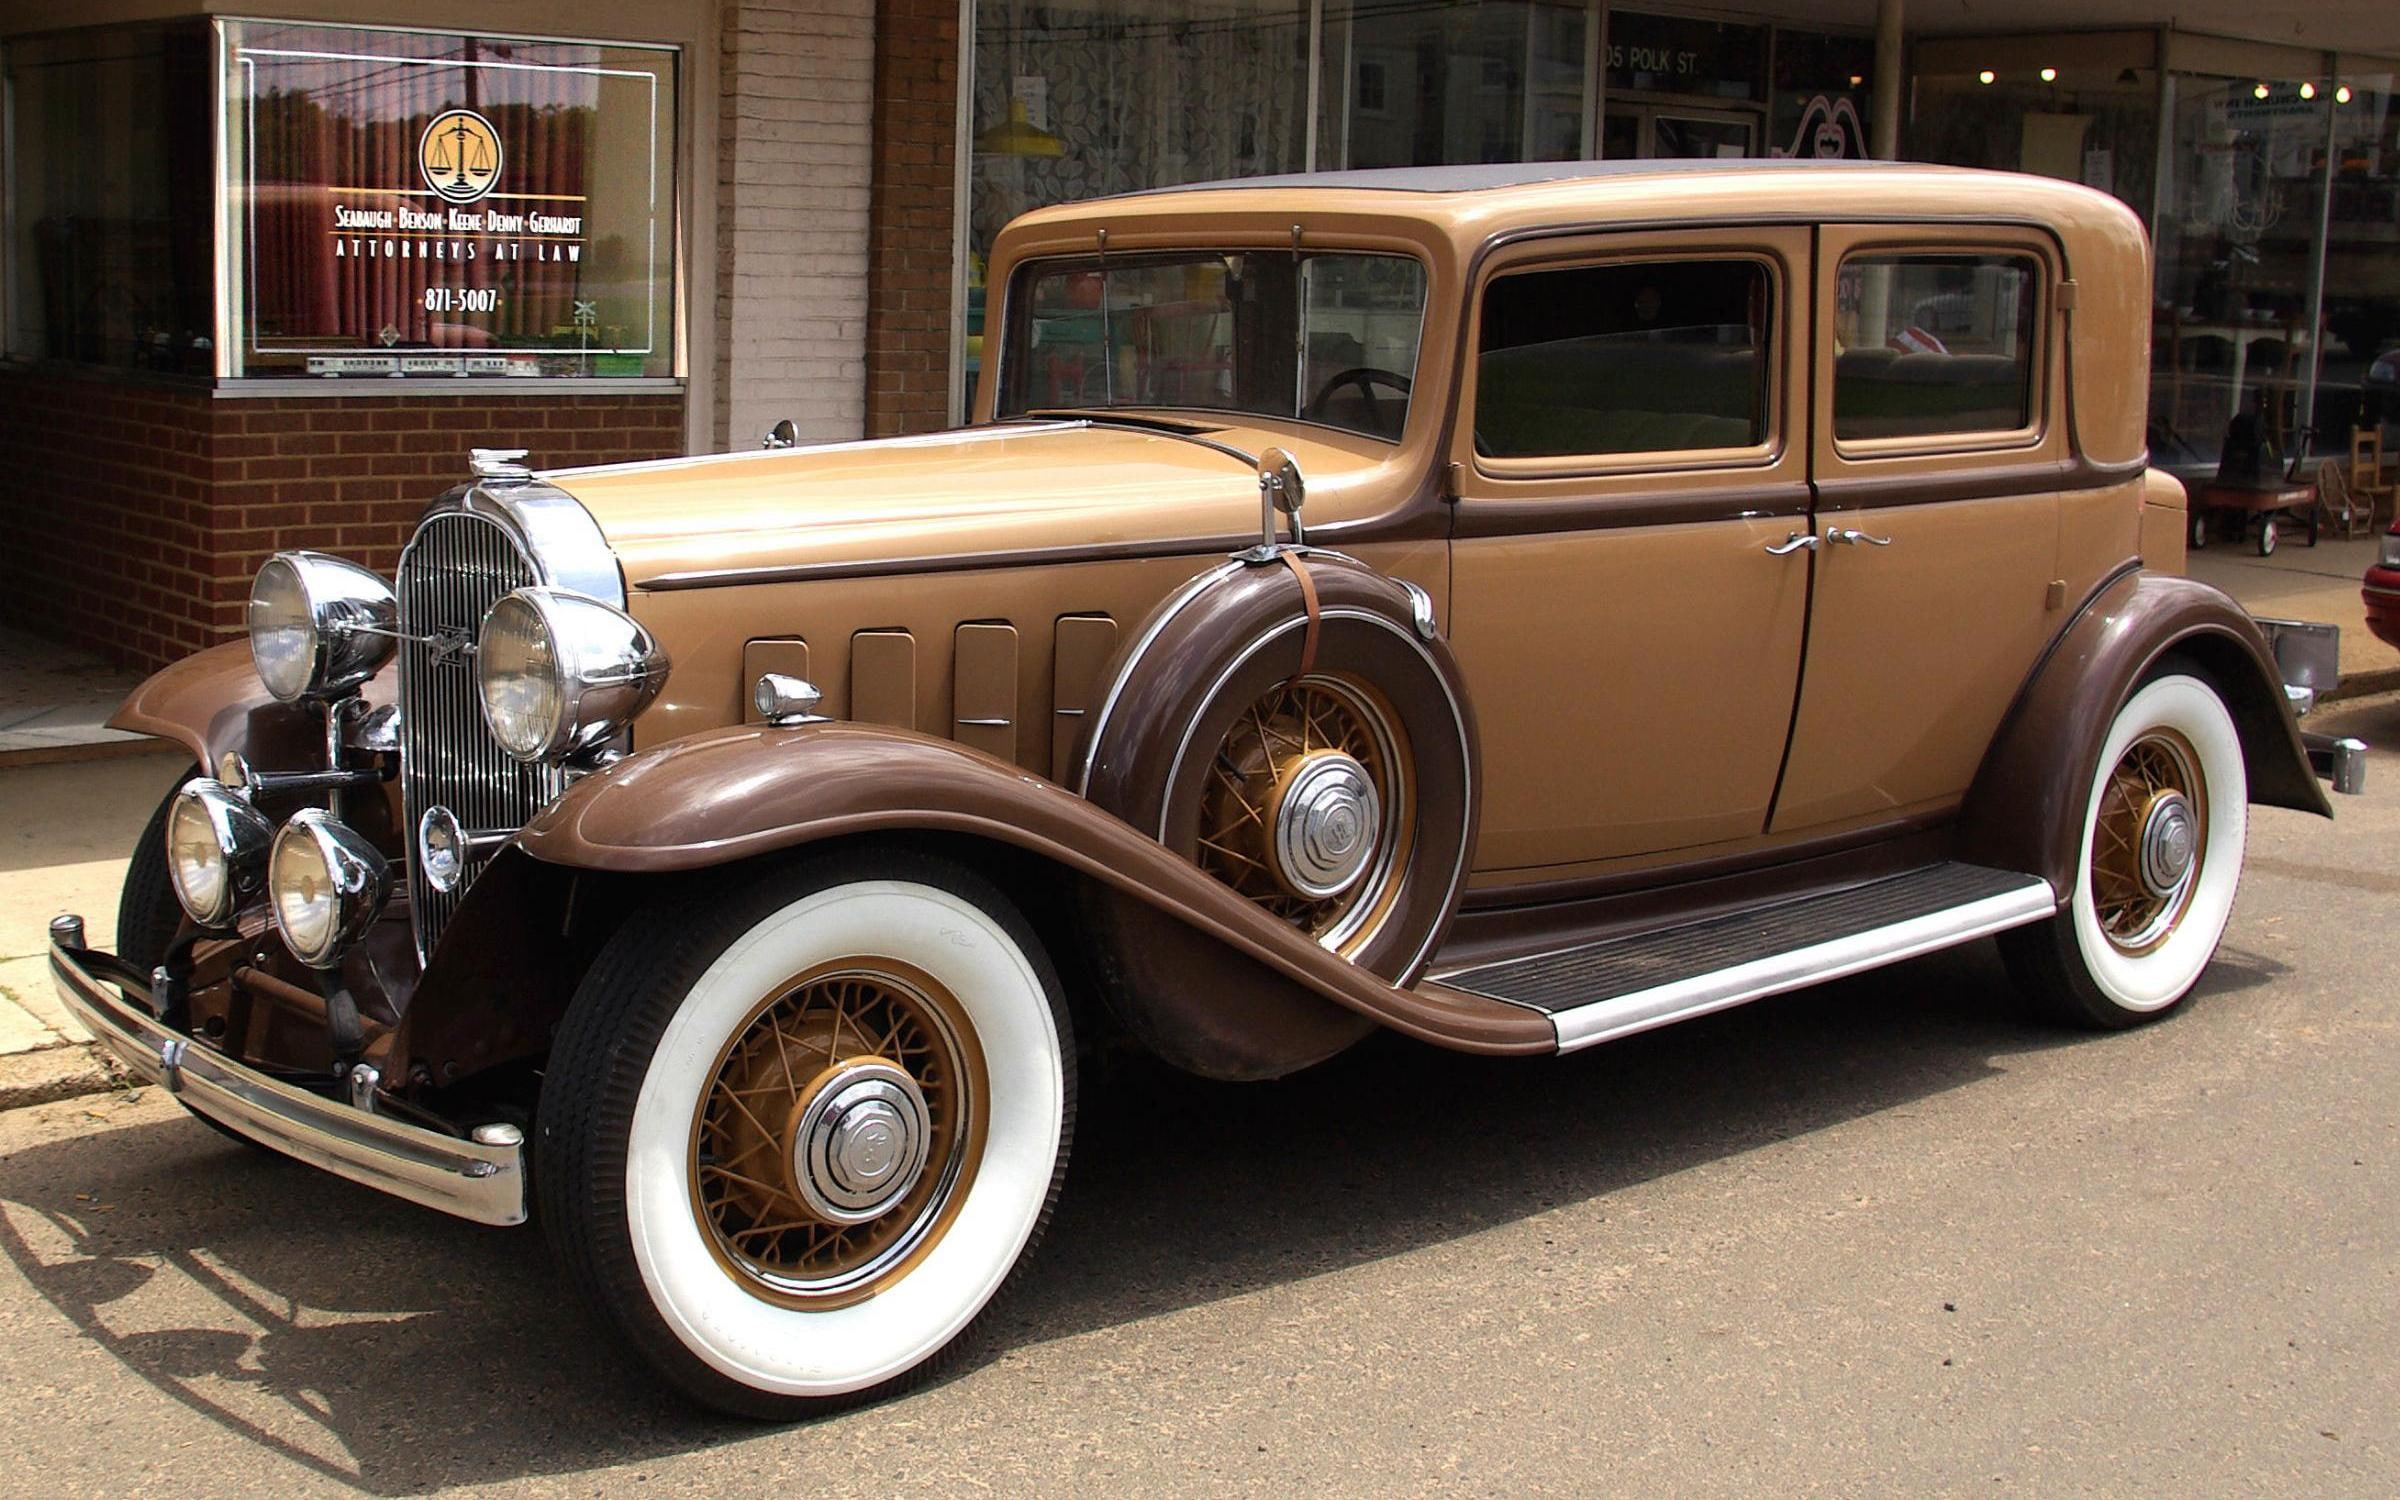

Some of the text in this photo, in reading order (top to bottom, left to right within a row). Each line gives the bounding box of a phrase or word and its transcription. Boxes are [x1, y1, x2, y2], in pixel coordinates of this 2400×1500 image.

[1630, 47, 1670, 72] POLK
[398, 206, 442, 231] BENSON
[448, 207, 482, 231] KEENE
[487, 208, 523, 233] DENNY
[335, 239, 581, 262] ATTORNEYS AT LAW
[424, 288, 497, 312] 871-5007
